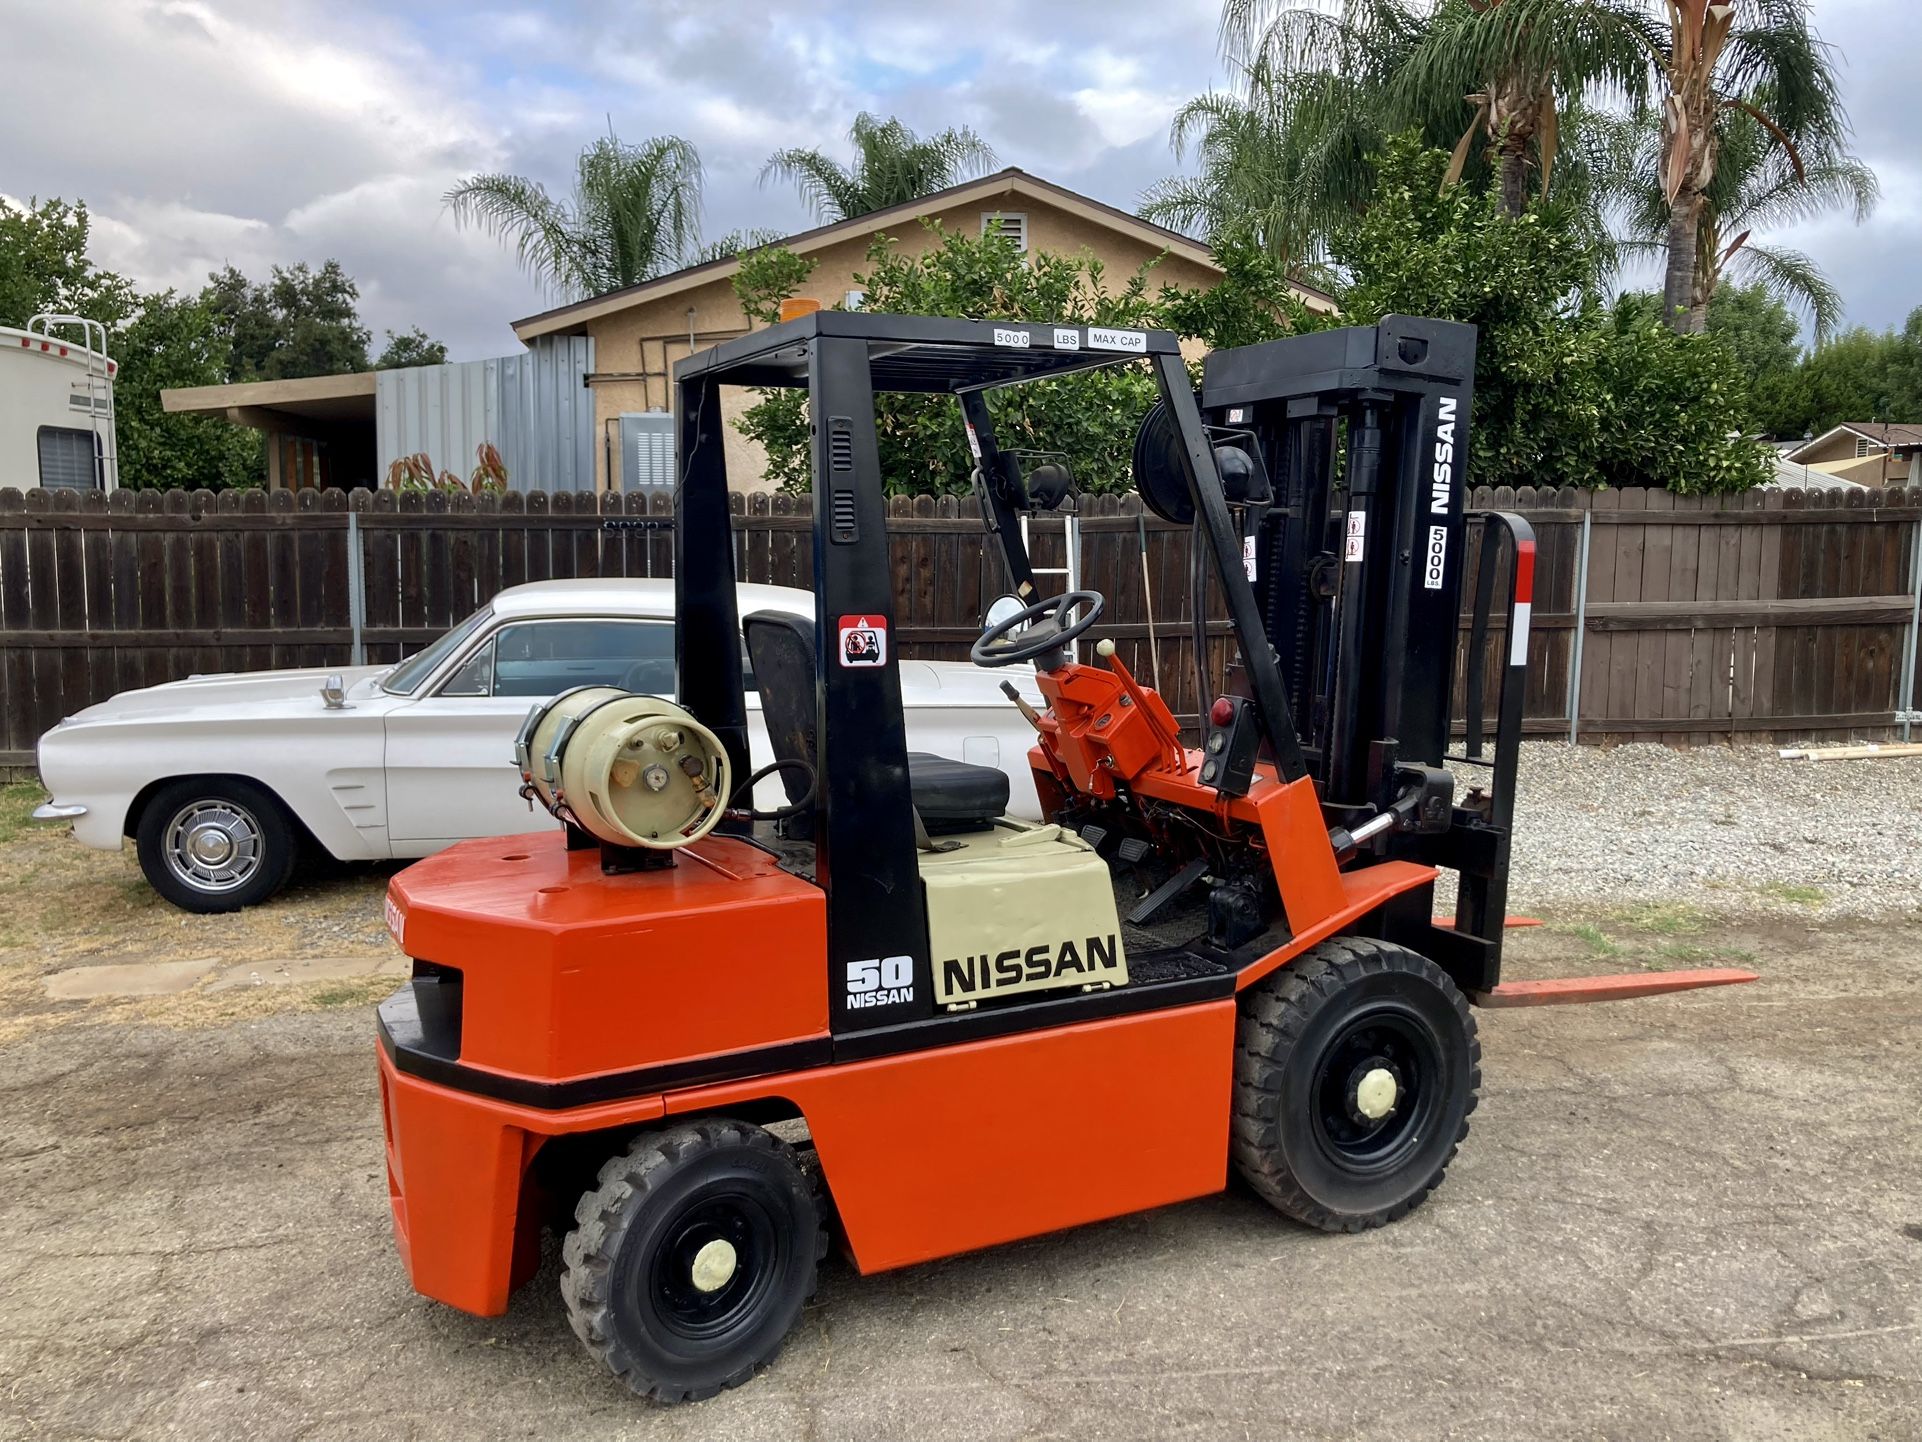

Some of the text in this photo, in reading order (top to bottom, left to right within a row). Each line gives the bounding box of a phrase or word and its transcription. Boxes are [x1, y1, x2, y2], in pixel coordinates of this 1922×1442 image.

[996, 332, 1141, 347] 5000 LBS MAX CAP
[1430, 396, 1457, 515] NISSAN
[1429, 528, 1444, 580] 5000
[847, 955, 913, 993] 50
[943, 934, 1117, 996] NISSAN
[847, 987, 913, 1010] NISSAN
